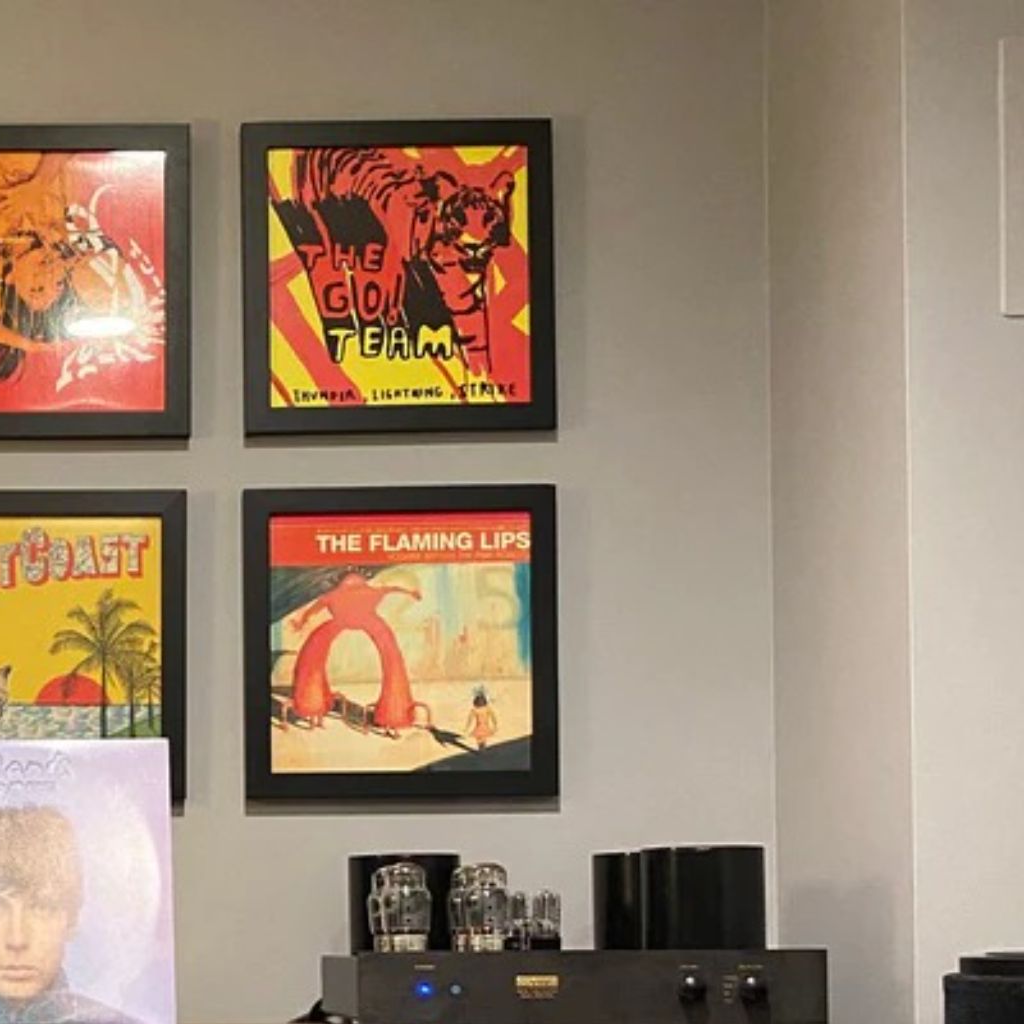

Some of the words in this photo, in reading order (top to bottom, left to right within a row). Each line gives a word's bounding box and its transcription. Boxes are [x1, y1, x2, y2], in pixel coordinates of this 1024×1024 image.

[296, 243, 386, 273] THE
[322, 273, 402, 325] GO!
[326, 324, 454, 364] TEAM
[20, 527, 149, 587] COAST
[316, 534, 362, 553] THE
[369, 532, 474, 552] FLAMING
[480, 531, 531, 551] LIPS
